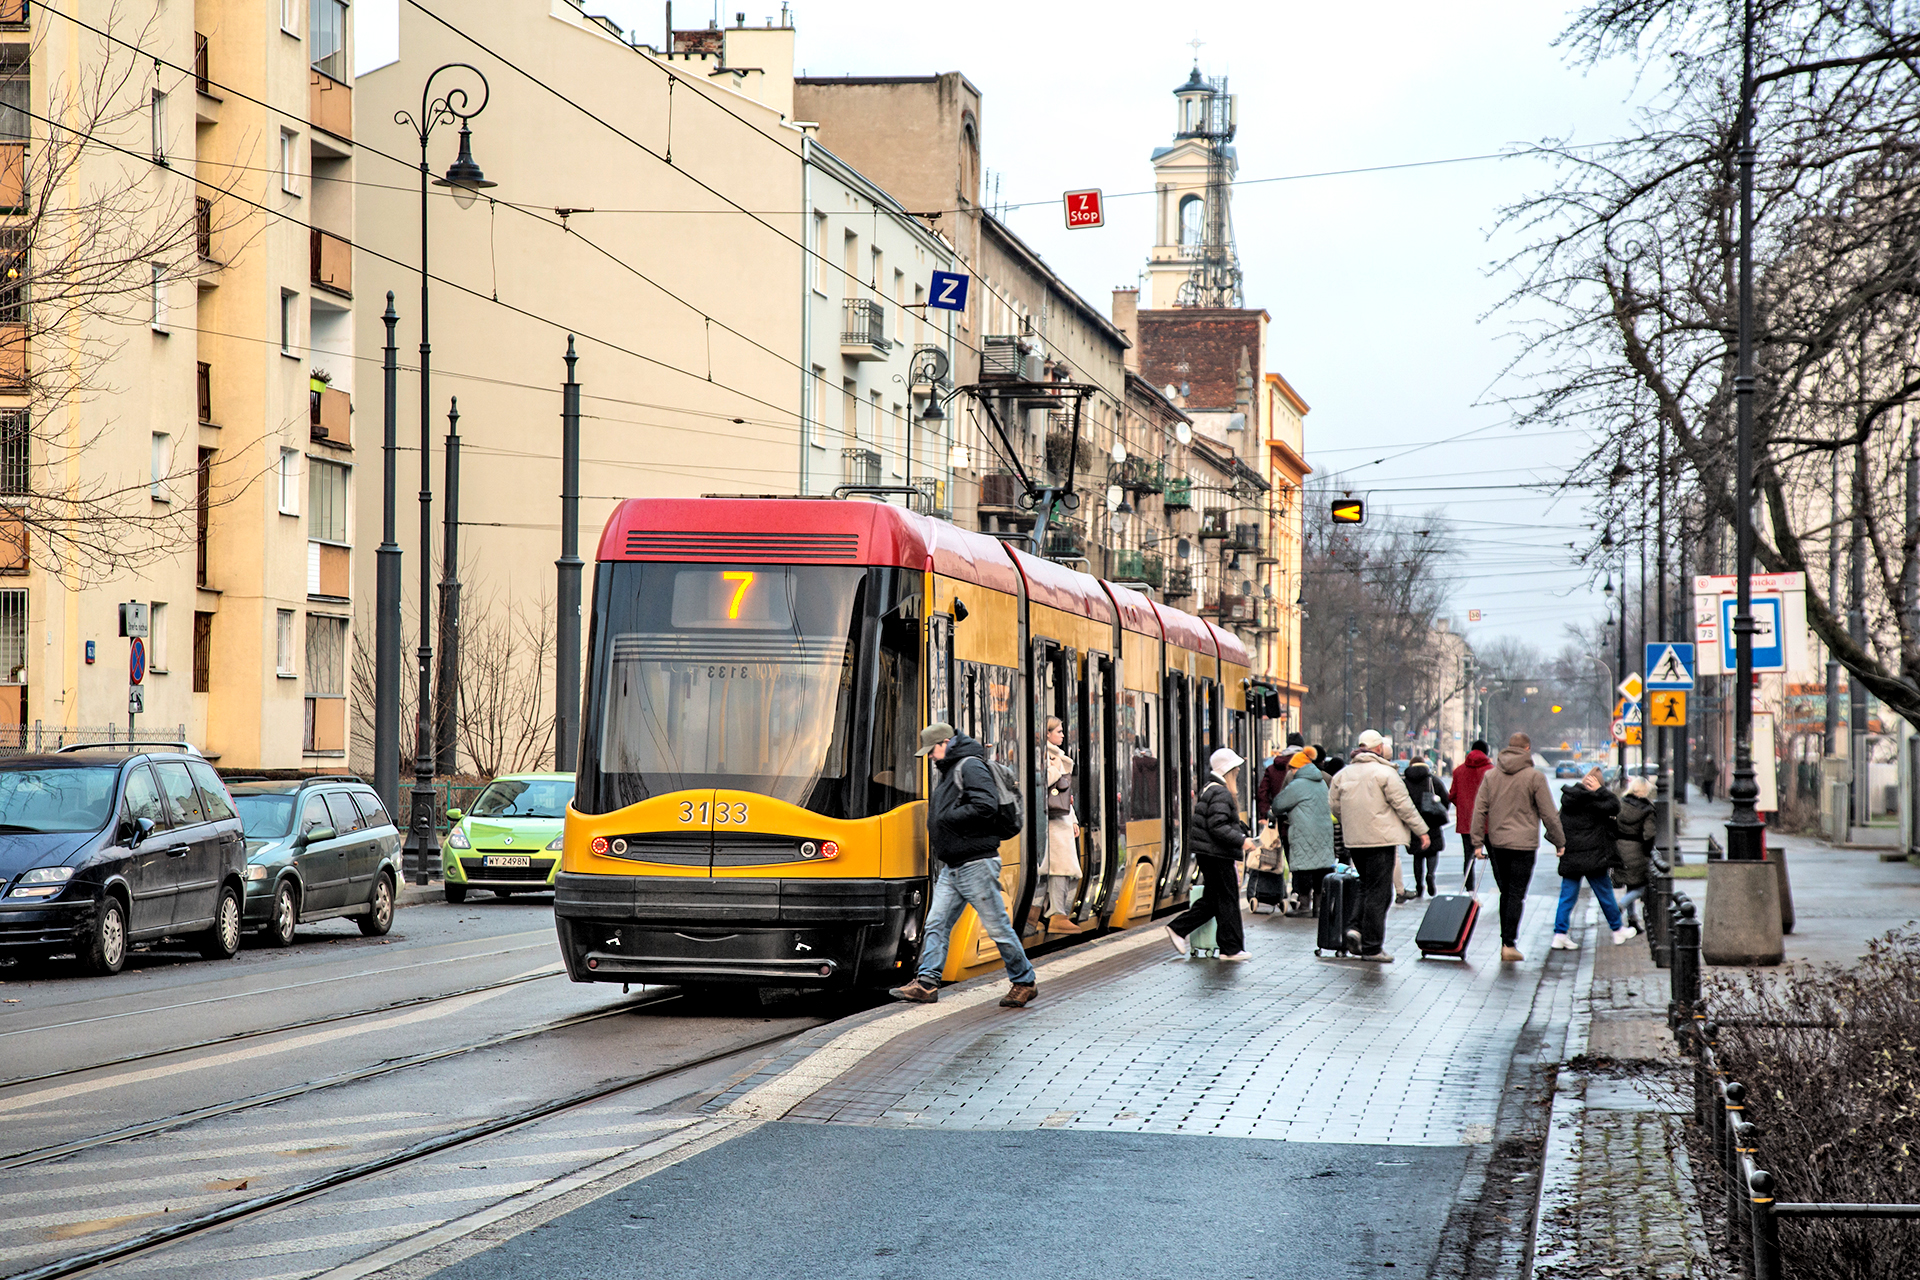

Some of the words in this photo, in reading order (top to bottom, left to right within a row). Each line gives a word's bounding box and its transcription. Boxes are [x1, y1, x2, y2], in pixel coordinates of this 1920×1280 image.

[1079, 195, 1089, 210] Z
[1071, 210, 1098, 223] Stop
[938, 278, 959, 305] Z
[1784, 577, 1796, 586] 02
[723, 571, 754, 620] 7
[1701, 629, 1714, 638] 73
[678, 800, 749, 825] 3133
[488, 857, 499, 865] WY
[502, 857, 528, 866] 2498N
